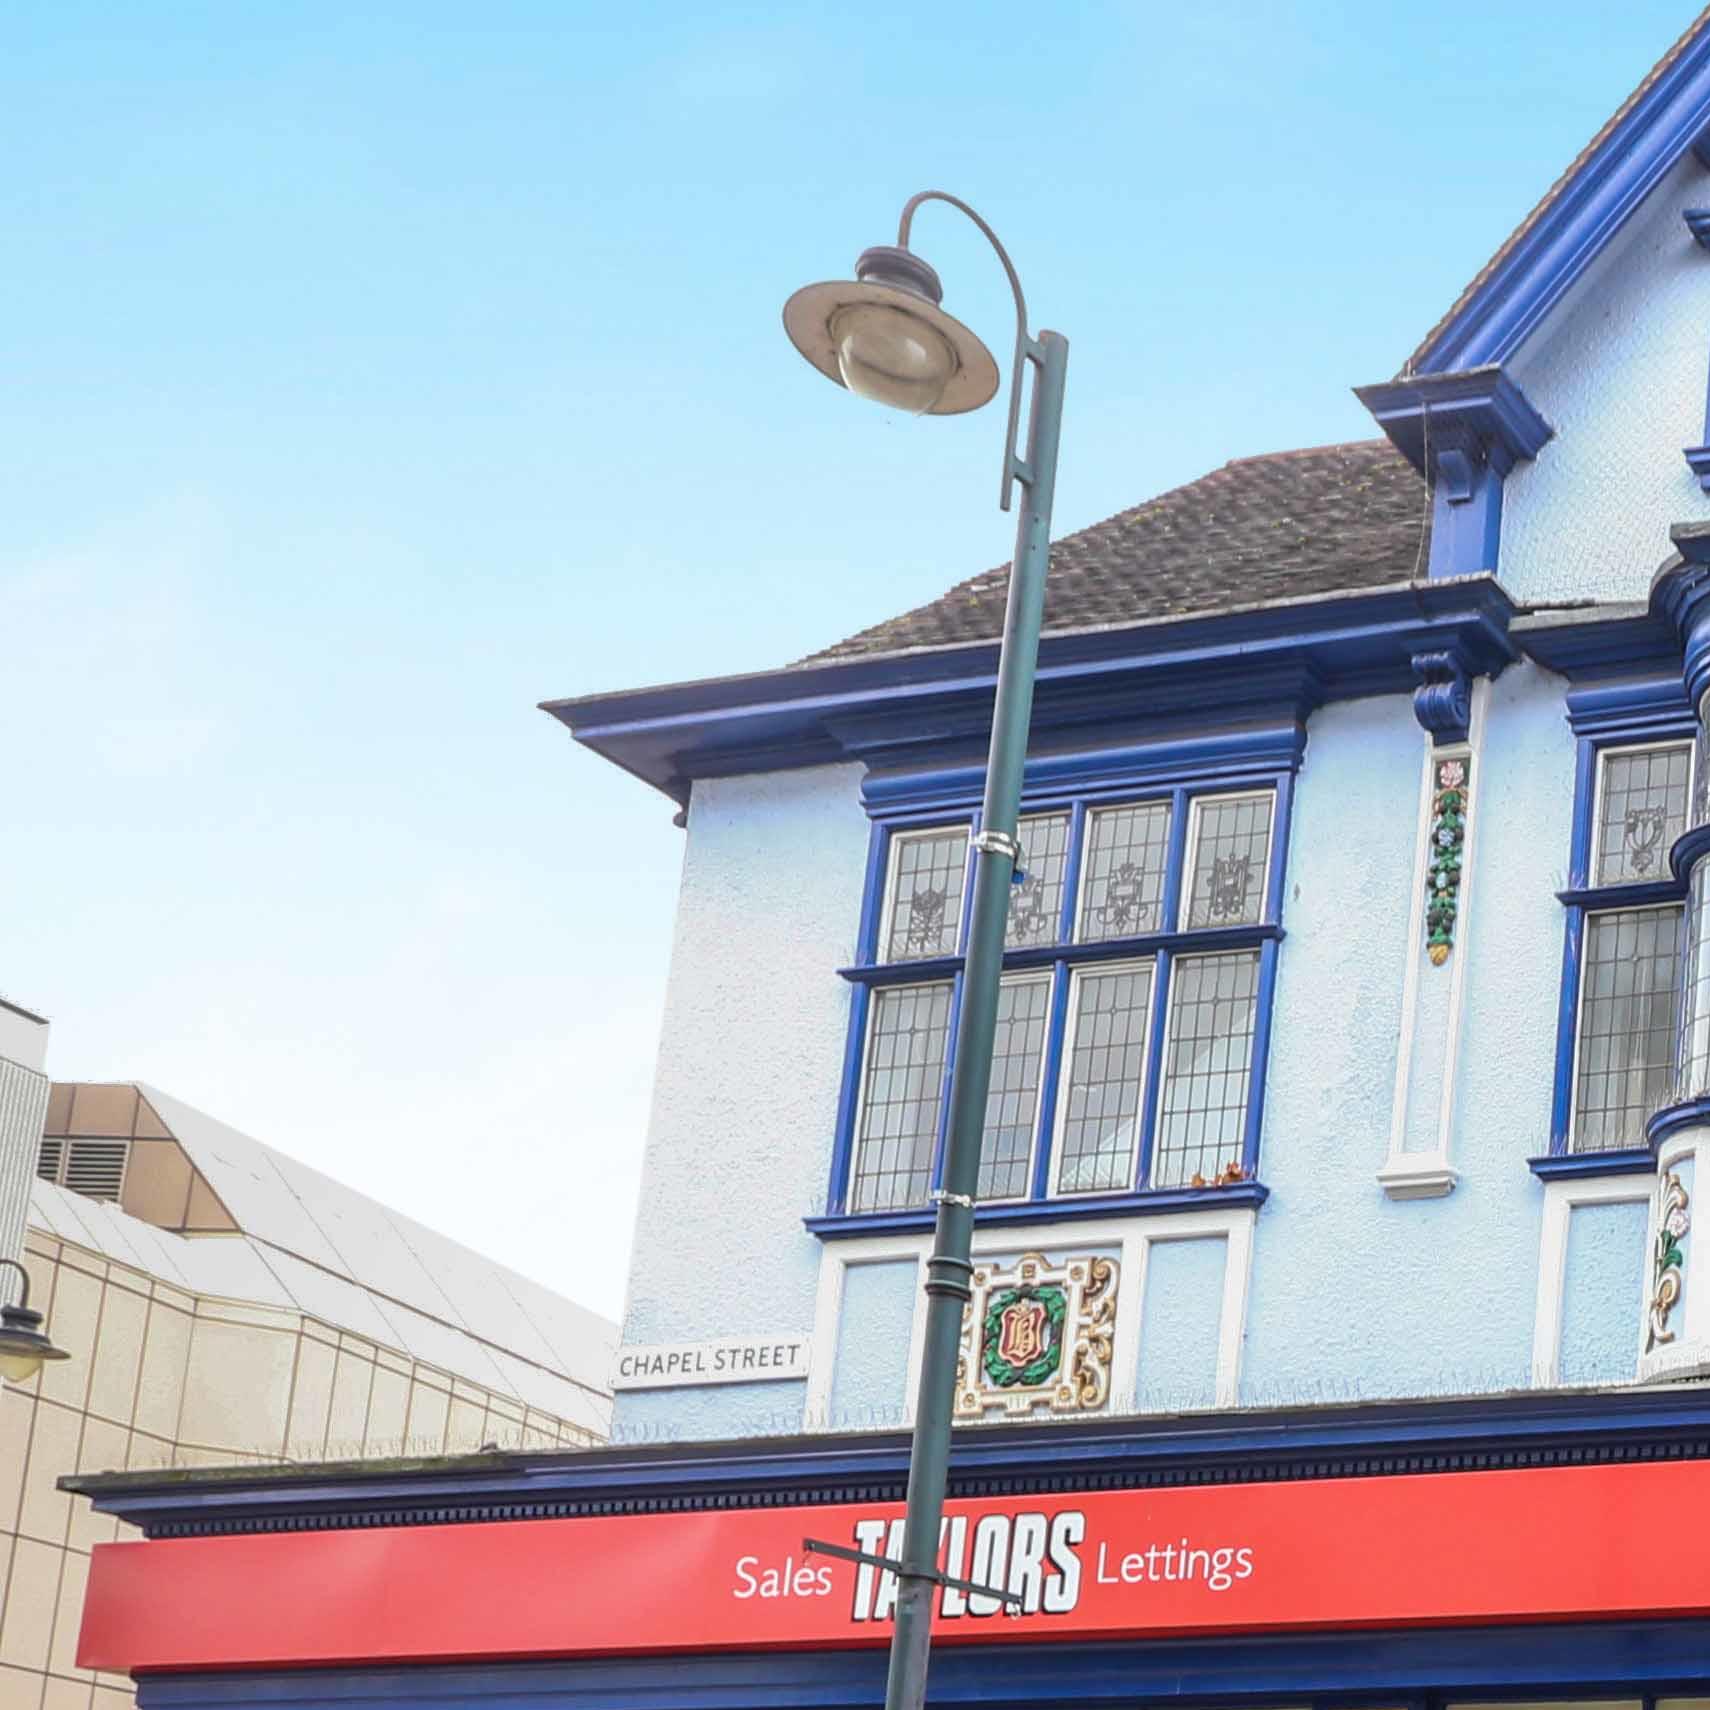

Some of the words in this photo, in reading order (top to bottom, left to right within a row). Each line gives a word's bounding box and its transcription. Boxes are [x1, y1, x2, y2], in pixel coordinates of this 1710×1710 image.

[620, 1350, 706, 1377] CHAPEL
[713, 1344, 801, 1371] STREET
[733, 1554, 833, 1599] Sales
[851, 1511, 1087, 1621] TALORS
[1097, 1537, 1253, 1591] Lettings
